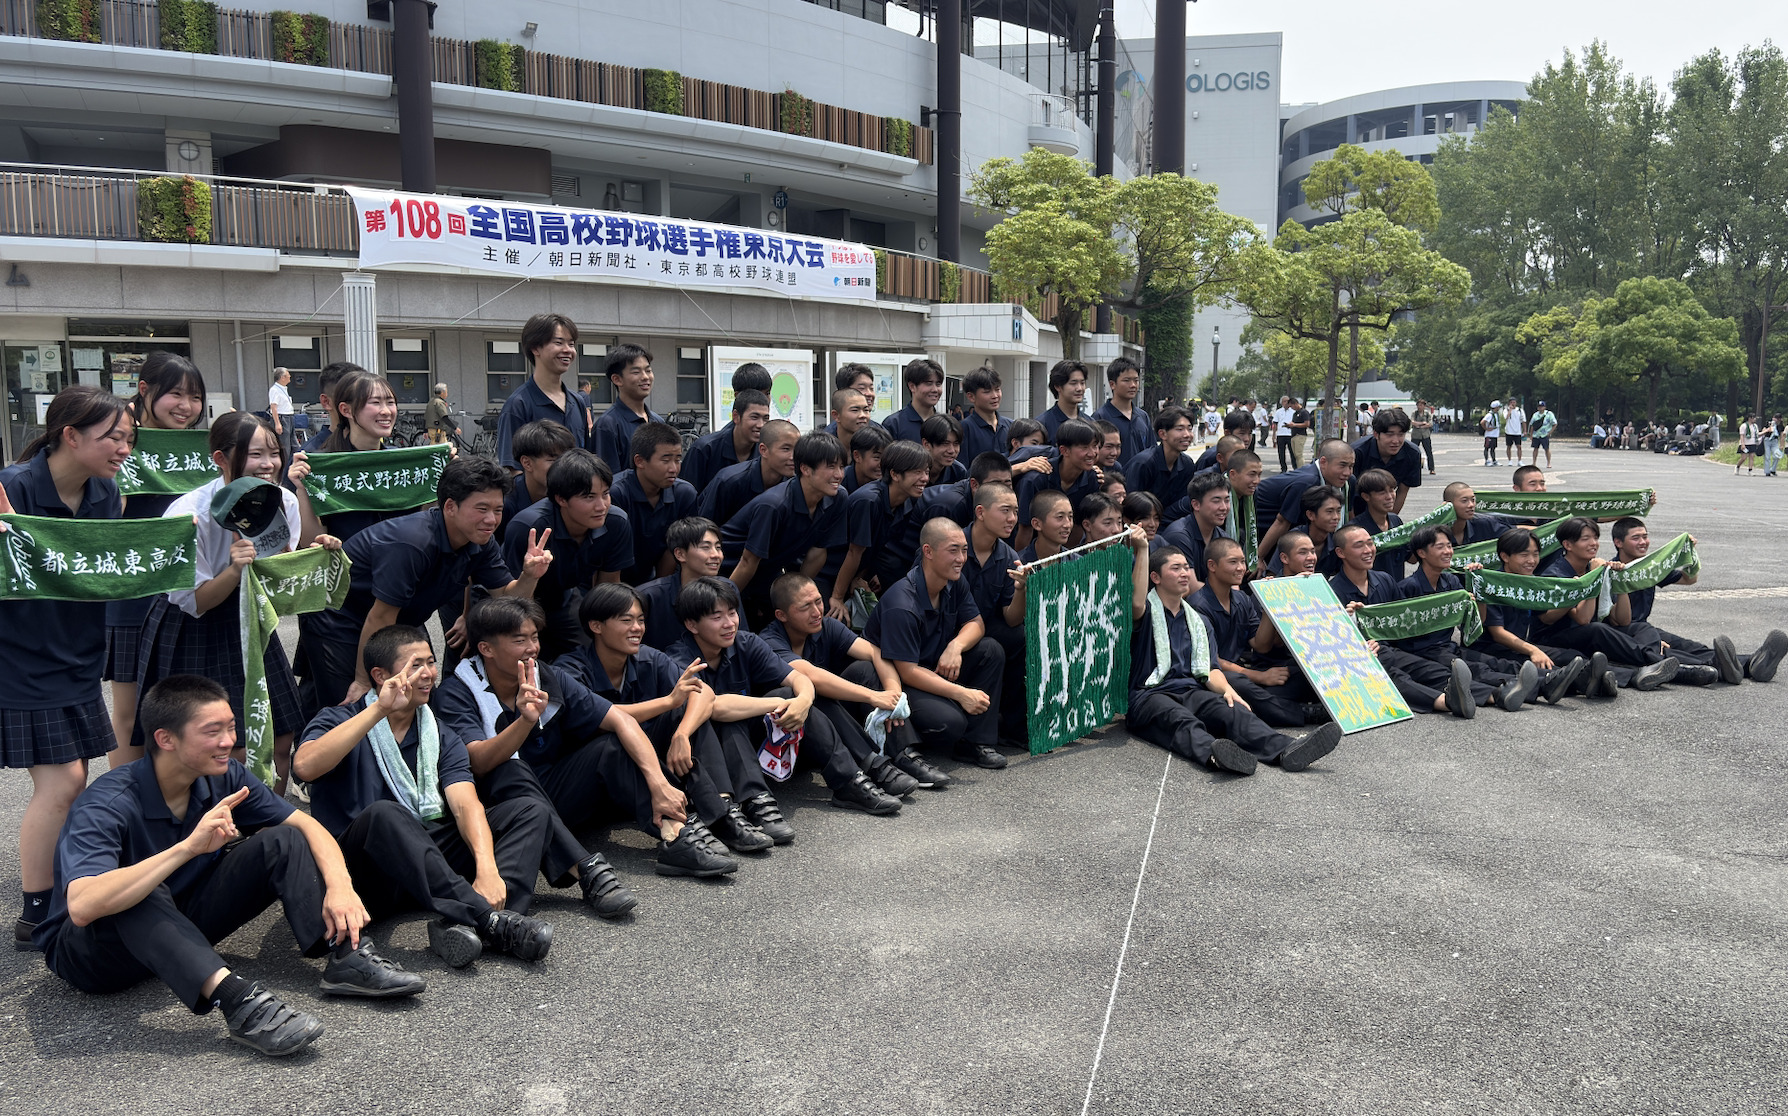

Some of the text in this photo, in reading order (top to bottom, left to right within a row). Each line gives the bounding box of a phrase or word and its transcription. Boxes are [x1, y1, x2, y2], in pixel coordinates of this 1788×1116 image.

[775, 196, 785, 207] R1
[6, 263, 30, 287] ム
[844, 277, 871, 287] 朝日新聞
[333, 466, 429, 493] 硬式野球部
[40, 543, 189, 577] 都立城東高校
[1260, 581, 1305, 601] 2026
[1485, 583, 1546, 603] 都立城東高校
[1035, 570, 1123, 715] 勝
[1048, 693, 1111, 740] 2026
